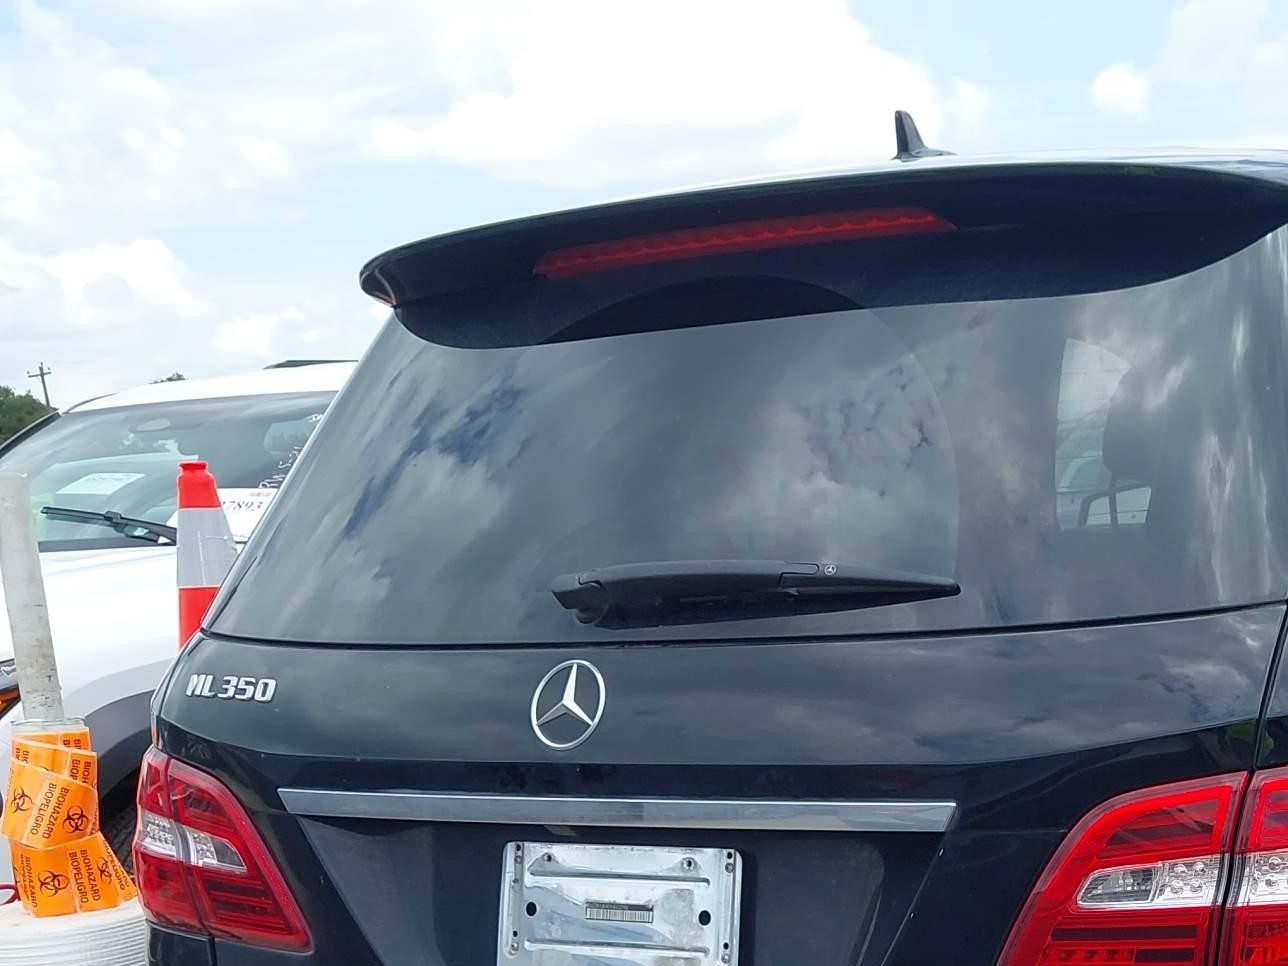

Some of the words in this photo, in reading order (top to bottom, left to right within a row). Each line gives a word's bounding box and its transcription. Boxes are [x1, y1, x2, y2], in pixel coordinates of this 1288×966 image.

[185, 673, 216, 698] ML
[217, 675, 277, 702] 350
[30, 782, 57, 836] BIOPELIGRO
[42, 787, 70, 839] BIOHAZARD
[68, 851, 89, 904] BIOPELIGRO
[80, 849, 101, 902] BIOHAZARD
